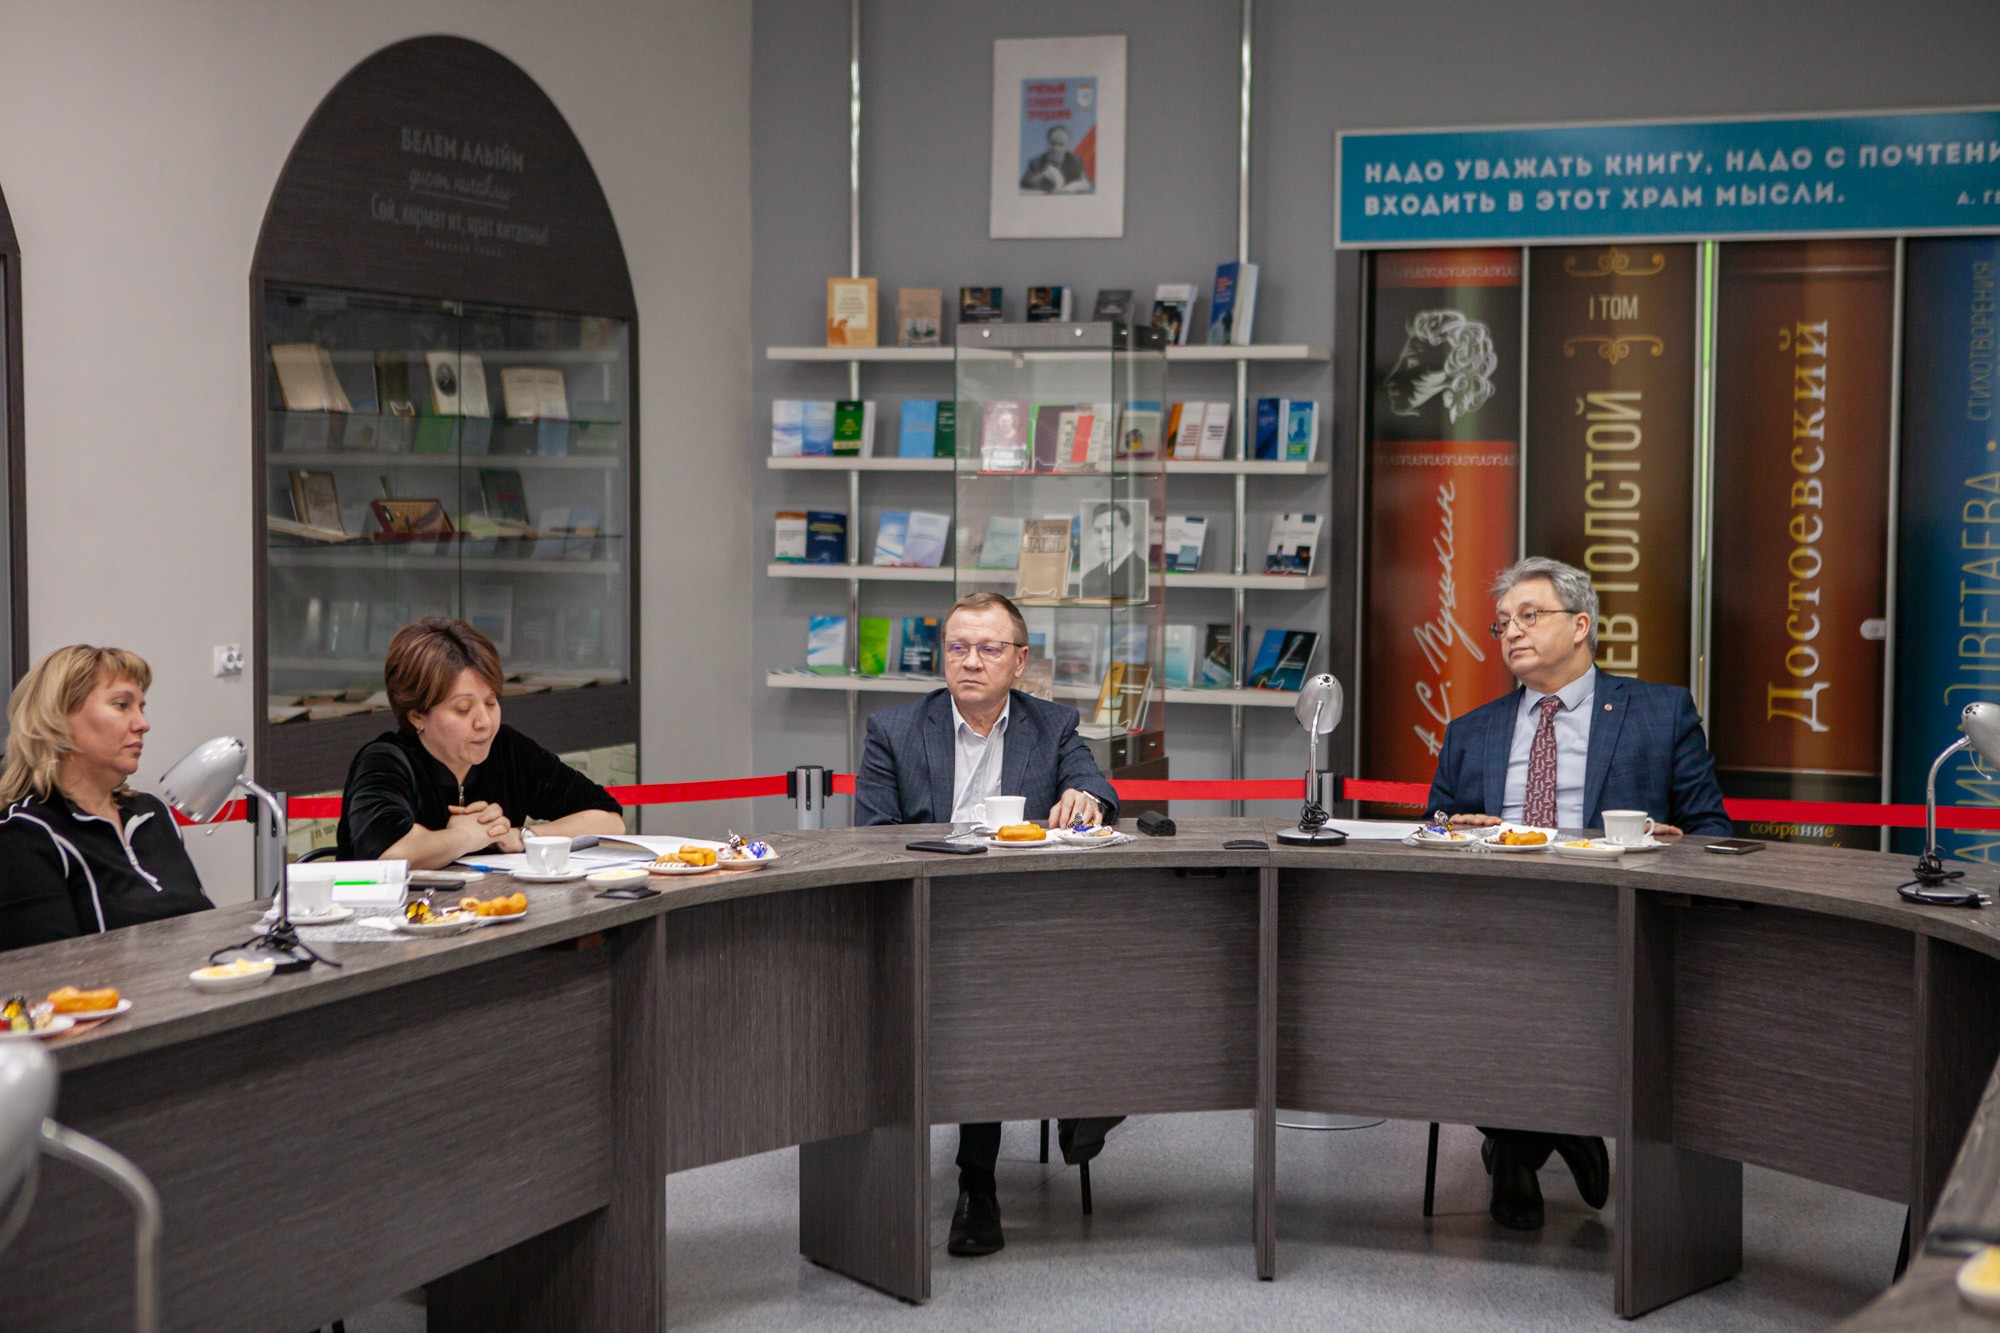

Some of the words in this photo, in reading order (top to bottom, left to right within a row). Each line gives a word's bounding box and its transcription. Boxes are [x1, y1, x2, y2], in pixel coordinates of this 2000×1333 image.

[1365, 159, 1445, 185] НАДО
[1455, 156, 1594, 182] УВАЖАТЬ
[1604, 151, 1712, 176] КНИГУ,
[1726, 146, 1813, 174] НАДО
[1824, 146, 1847, 169] С
[1364, 192, 1497, 217] ВХОДИТЬ
[1507, 190, 1524, 213] В
[1535, 188, 1610, 212] ЭТОТ
[1621, 185, 1703, 210] ХРАМ
[1715, 180, 1846, 208] МЫСЛИ.
[1600, 295, 1640, 322] ТОМ
[1767, 318, 1831, 733] Достоевский
[1413, 480, 1485, 675] Пушкин
[1596, 613, 1640, 679] ЕВ
[1749, 821, 1835, 839] собрание
